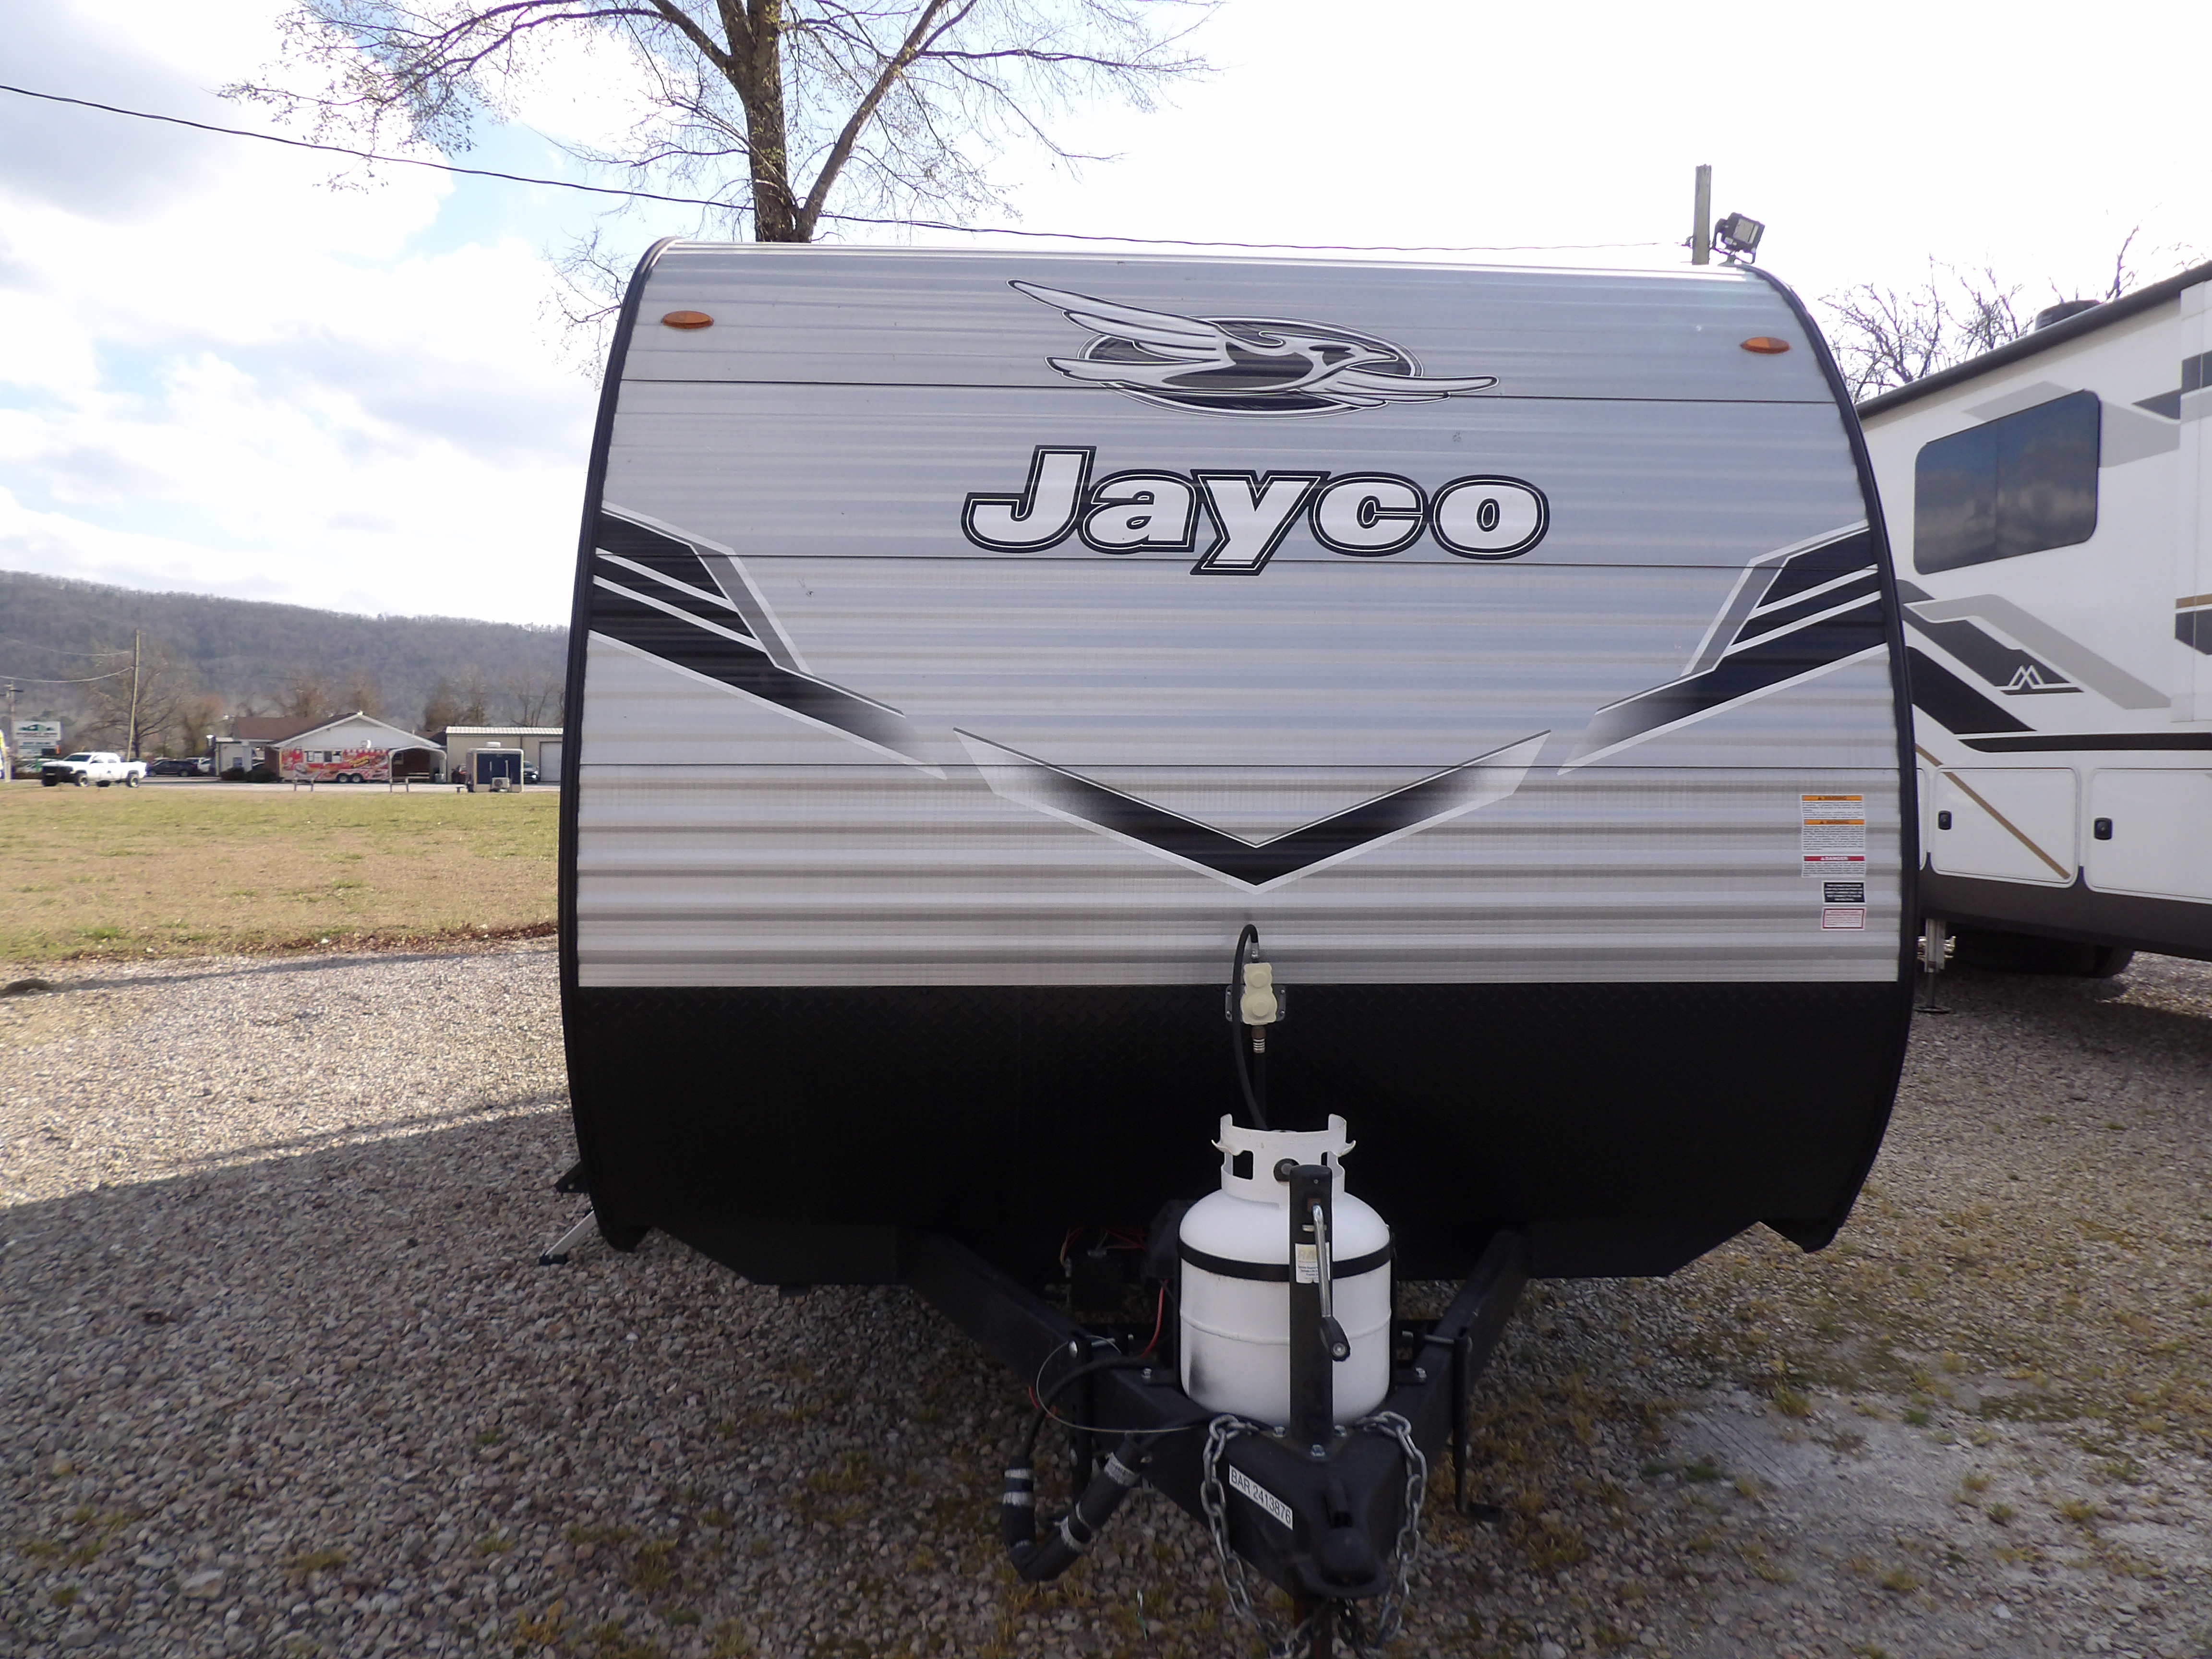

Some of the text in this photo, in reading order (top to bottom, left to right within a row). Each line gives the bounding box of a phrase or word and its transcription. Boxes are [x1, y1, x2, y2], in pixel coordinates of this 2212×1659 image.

[962, 445, 1549, 575] Jayco
[1231, 1470, 1291, 1525] BAR 2413876
